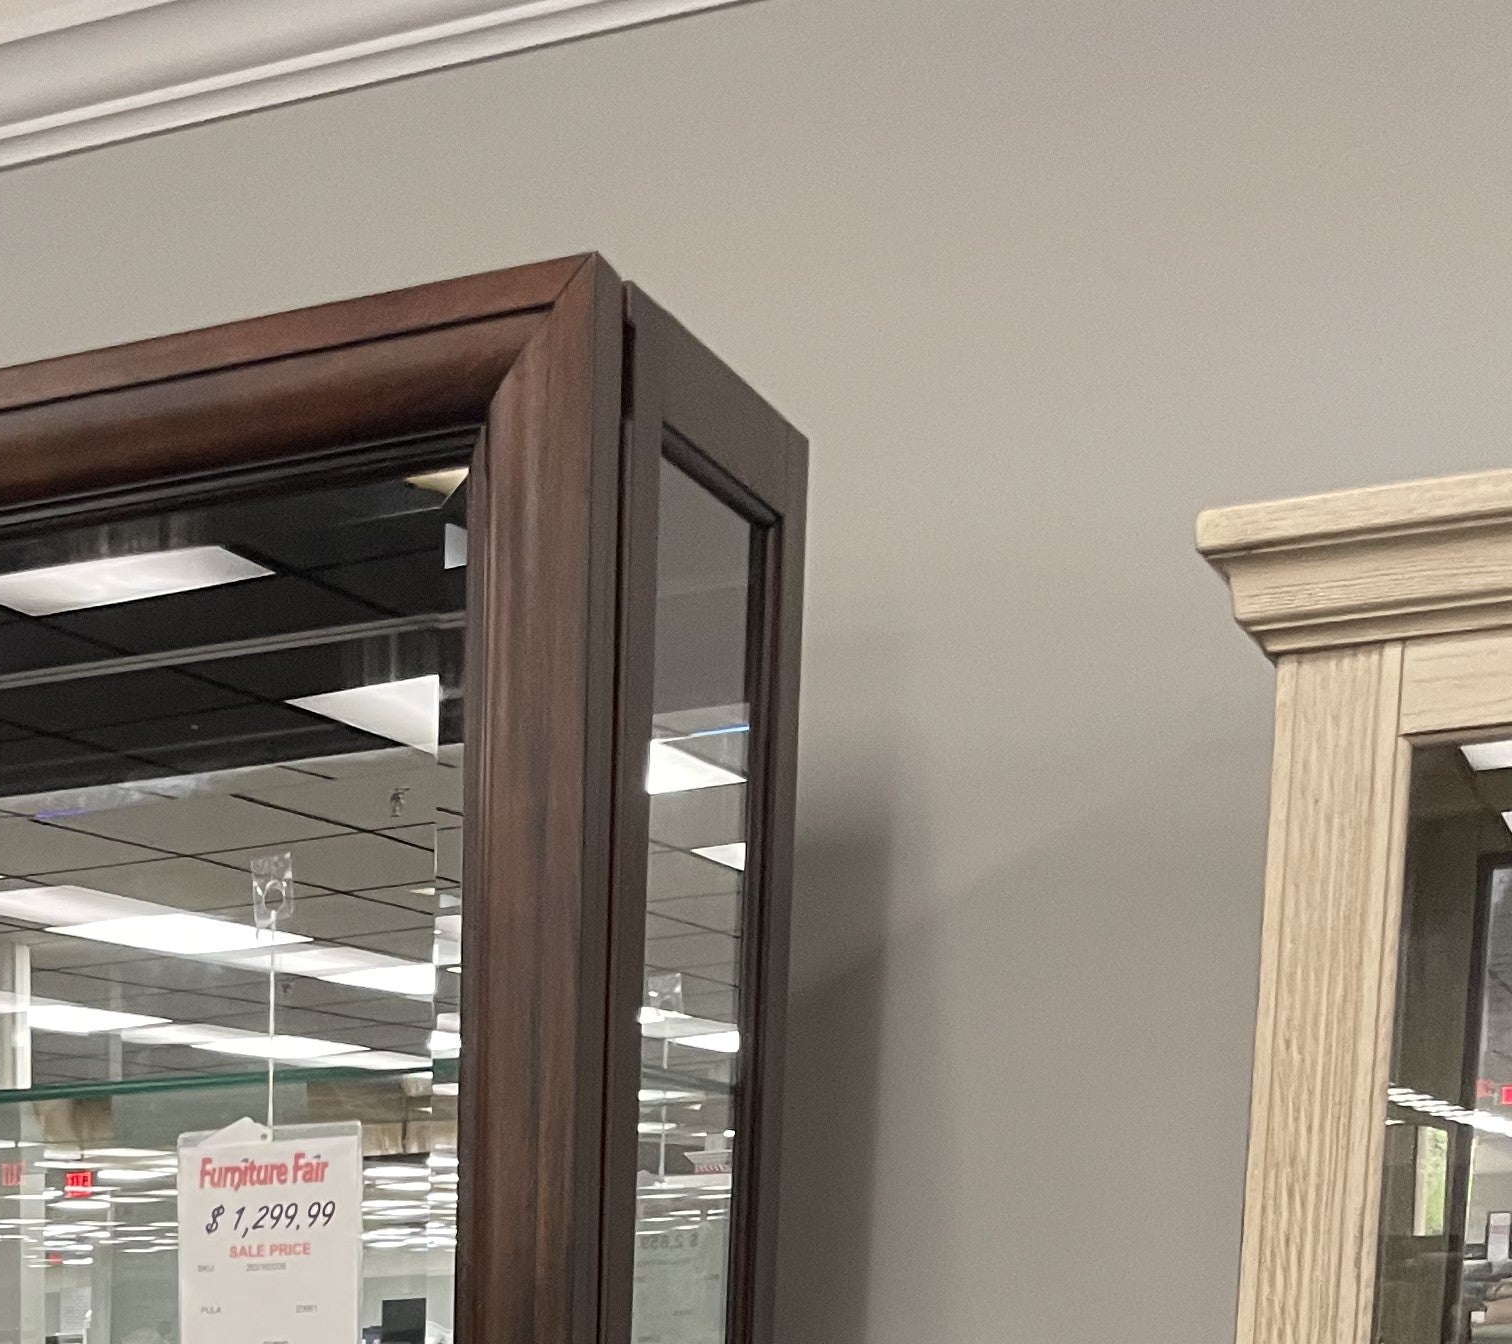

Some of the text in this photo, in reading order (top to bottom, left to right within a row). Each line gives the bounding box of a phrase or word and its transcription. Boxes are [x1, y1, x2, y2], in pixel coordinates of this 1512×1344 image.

[199, 1152, 329, 1192] Furniture Fair
[205, 1200, 336, 1238] $ 1,299.99
[229, 1242, 311, 1258] SALE PRICE
